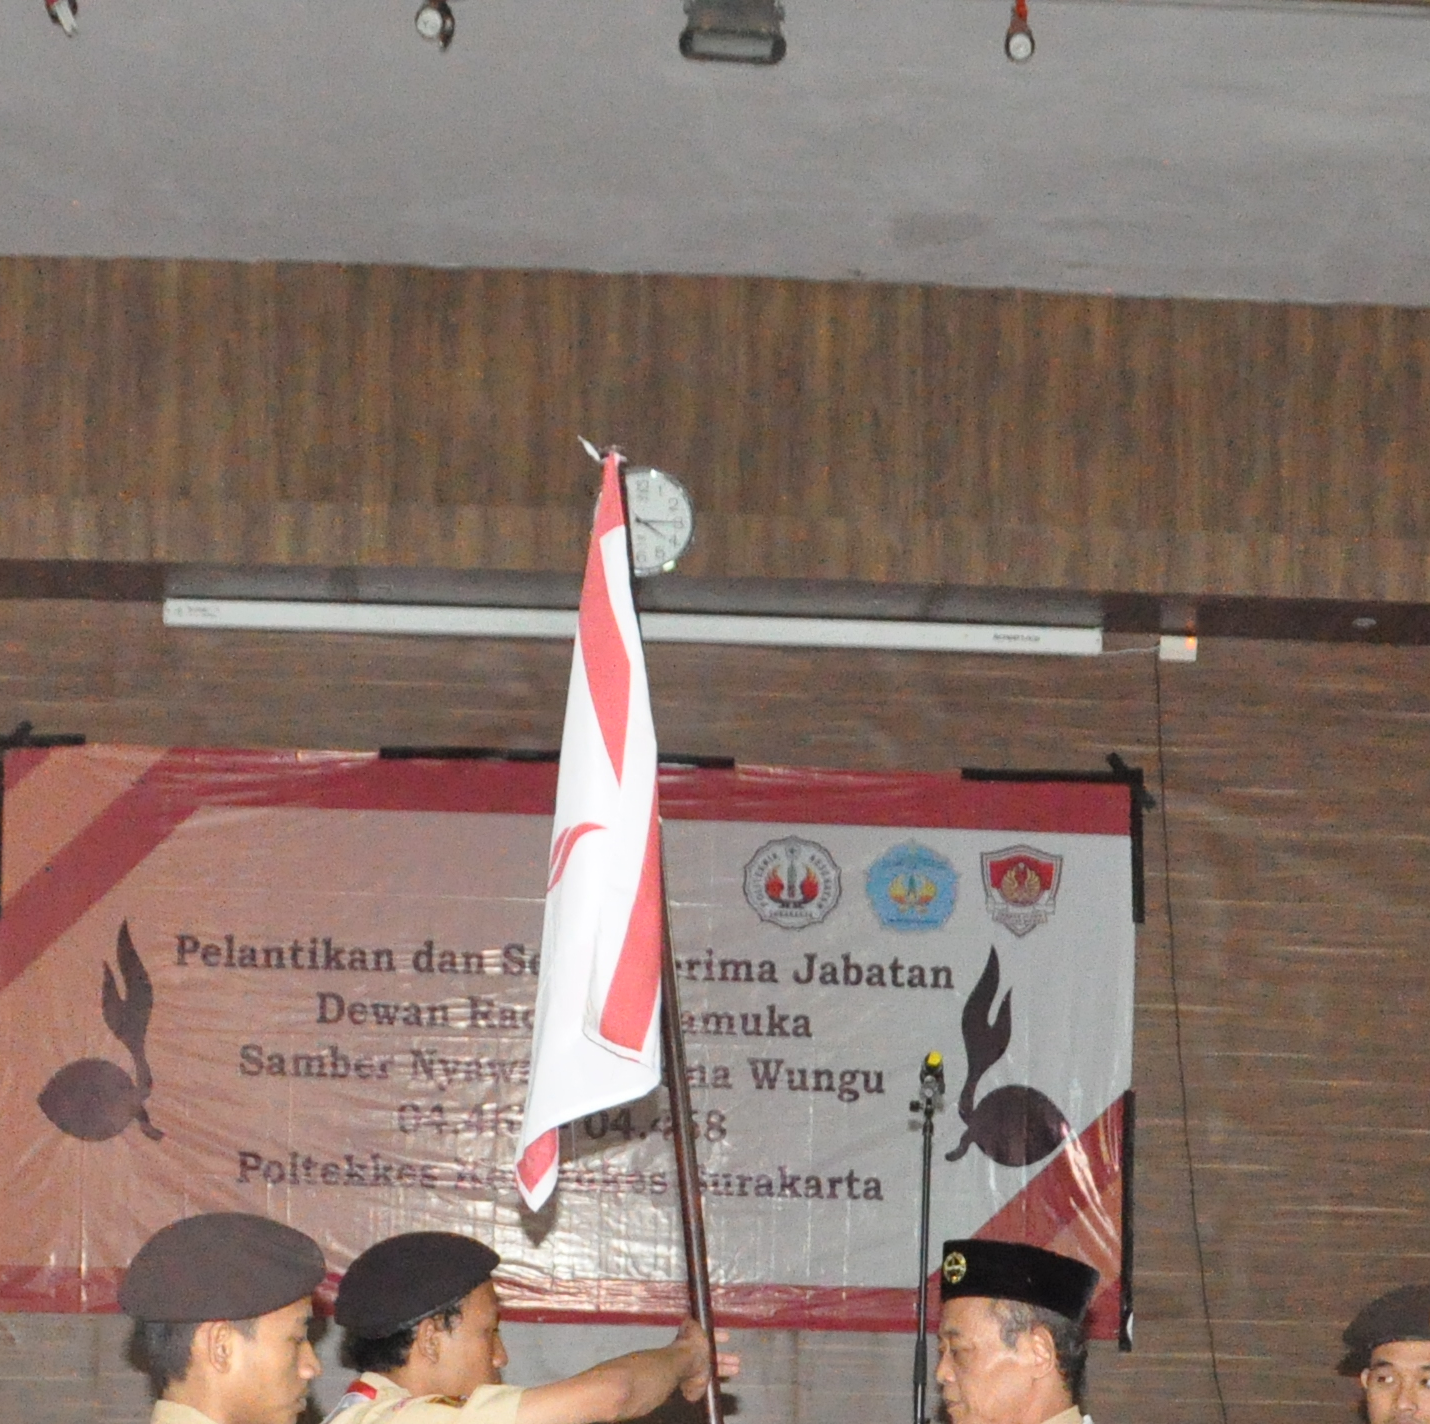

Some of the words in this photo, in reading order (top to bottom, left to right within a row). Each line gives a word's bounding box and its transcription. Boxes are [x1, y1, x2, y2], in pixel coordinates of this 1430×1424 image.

[175, 934, 395, 972] Pelantikan
[412, 940, 484, 976] dan
[792, 953, 954, 989] Jabatan
[316, 991, 450, 1027] Dewan
[239, 1044, 393, 1079] Samber
[747, 1057, 885, 1102] Wungu
[237, 1150, 438, 1188] Poltekkes
